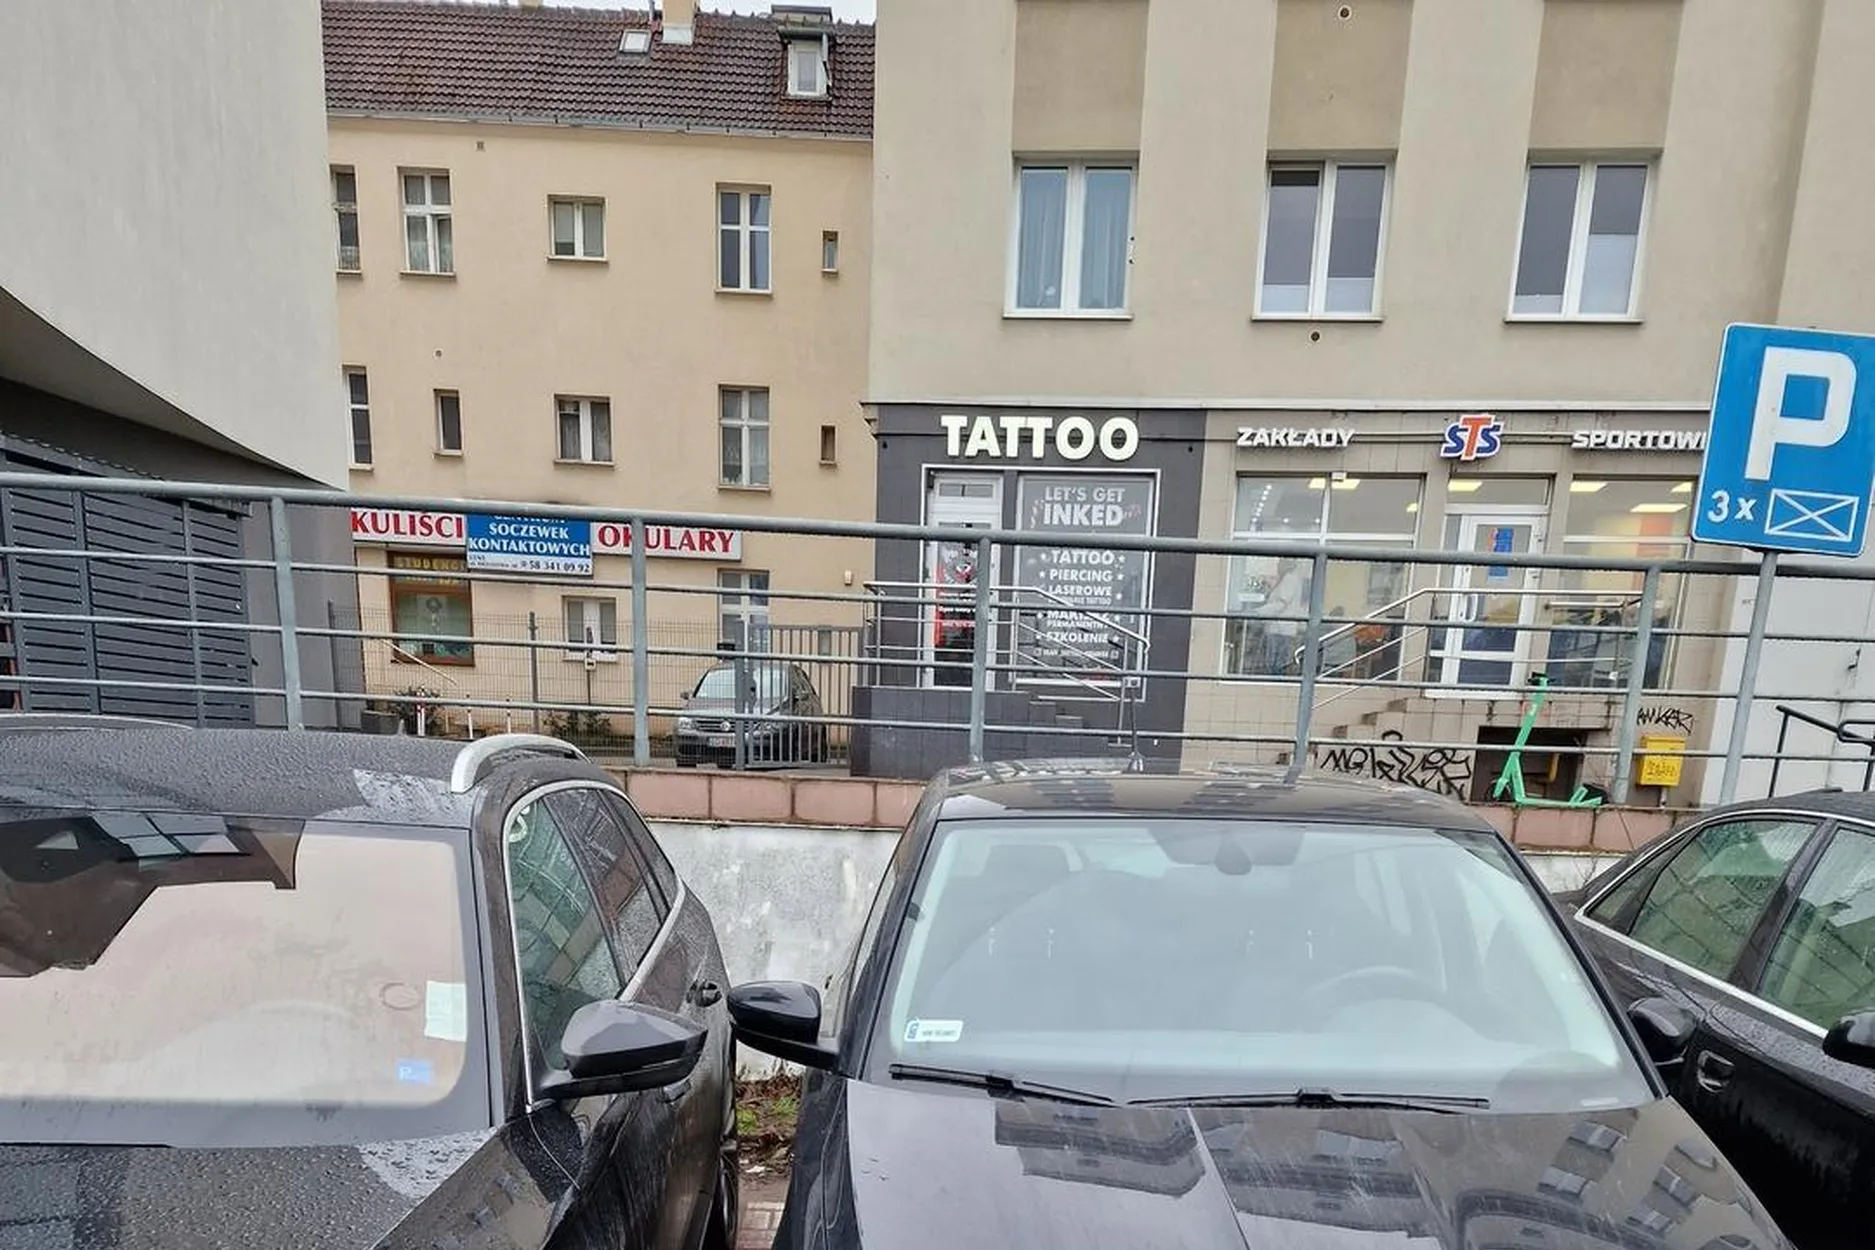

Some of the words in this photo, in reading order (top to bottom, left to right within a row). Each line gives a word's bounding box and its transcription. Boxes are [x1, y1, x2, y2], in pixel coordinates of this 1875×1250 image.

[1745, 346, 1857, 481] P
[941, 415, 1139, 461] TATTOO
[1236, 427, 1356, 448] ZAKŁADY
[1571, 429, 1707, 450] SPORTOW
[1440, 414, 1504, 460] STS
[1044, 486, 1087, 502] LET'S
[1092, 487, 1125, 503] GET
[1043, 503, 1124, 526] INKED
[489, 522, 569, 540] SOCZEWEK
[468, 537, 590, 556] KONTAKTOWYCH
[1051, 549, 1115, 565] TATTOO
[1049, 568, 1113, 582] PIERCING
[1047, 583, 1112, 597] LASEROWE
